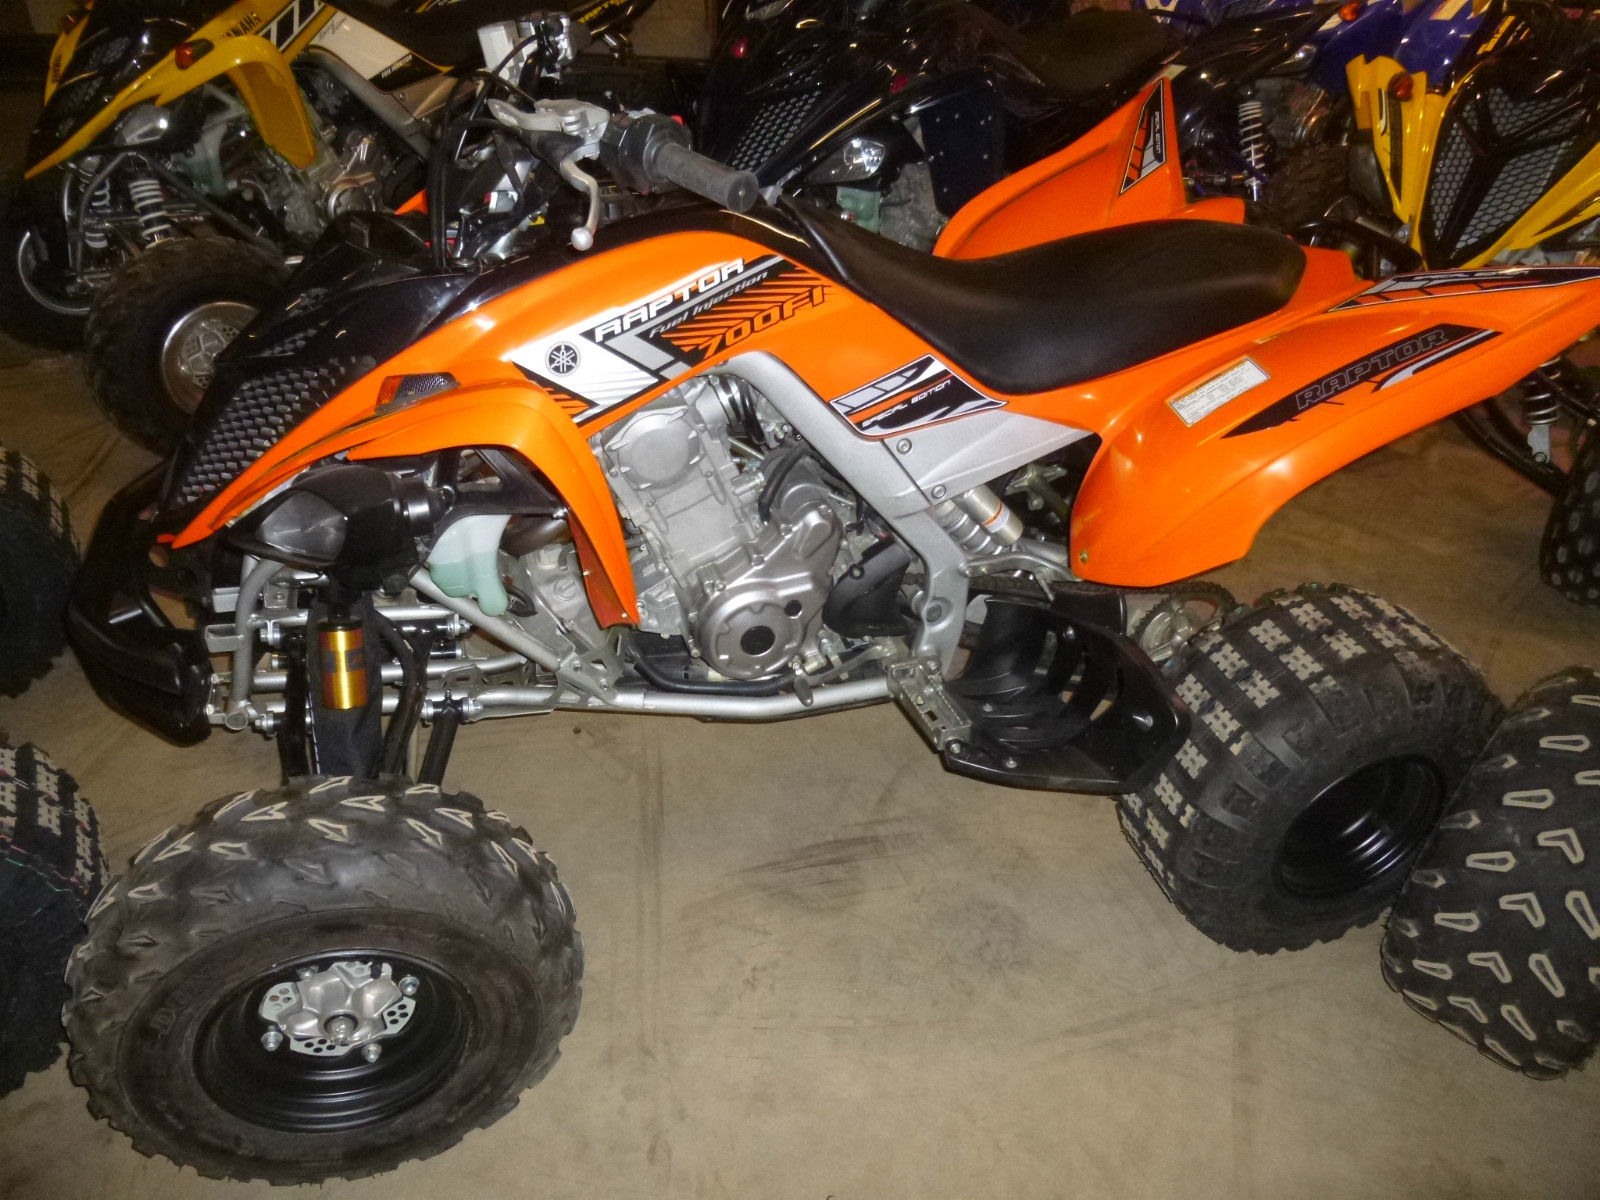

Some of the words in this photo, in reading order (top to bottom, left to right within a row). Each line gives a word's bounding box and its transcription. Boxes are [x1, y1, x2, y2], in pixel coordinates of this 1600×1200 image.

[594, 257, 745, 343] RAPTOR
[649, 313, 687, 339] Fuel
[692, 271, 767, 318] Injection
[698, 285, 827, 359] 700FI
[861, 402, 909, 428] SPECIAL
[910, 380, 952, 405] EDITION
[1295, 328, 1450, 410] RAPTOR
